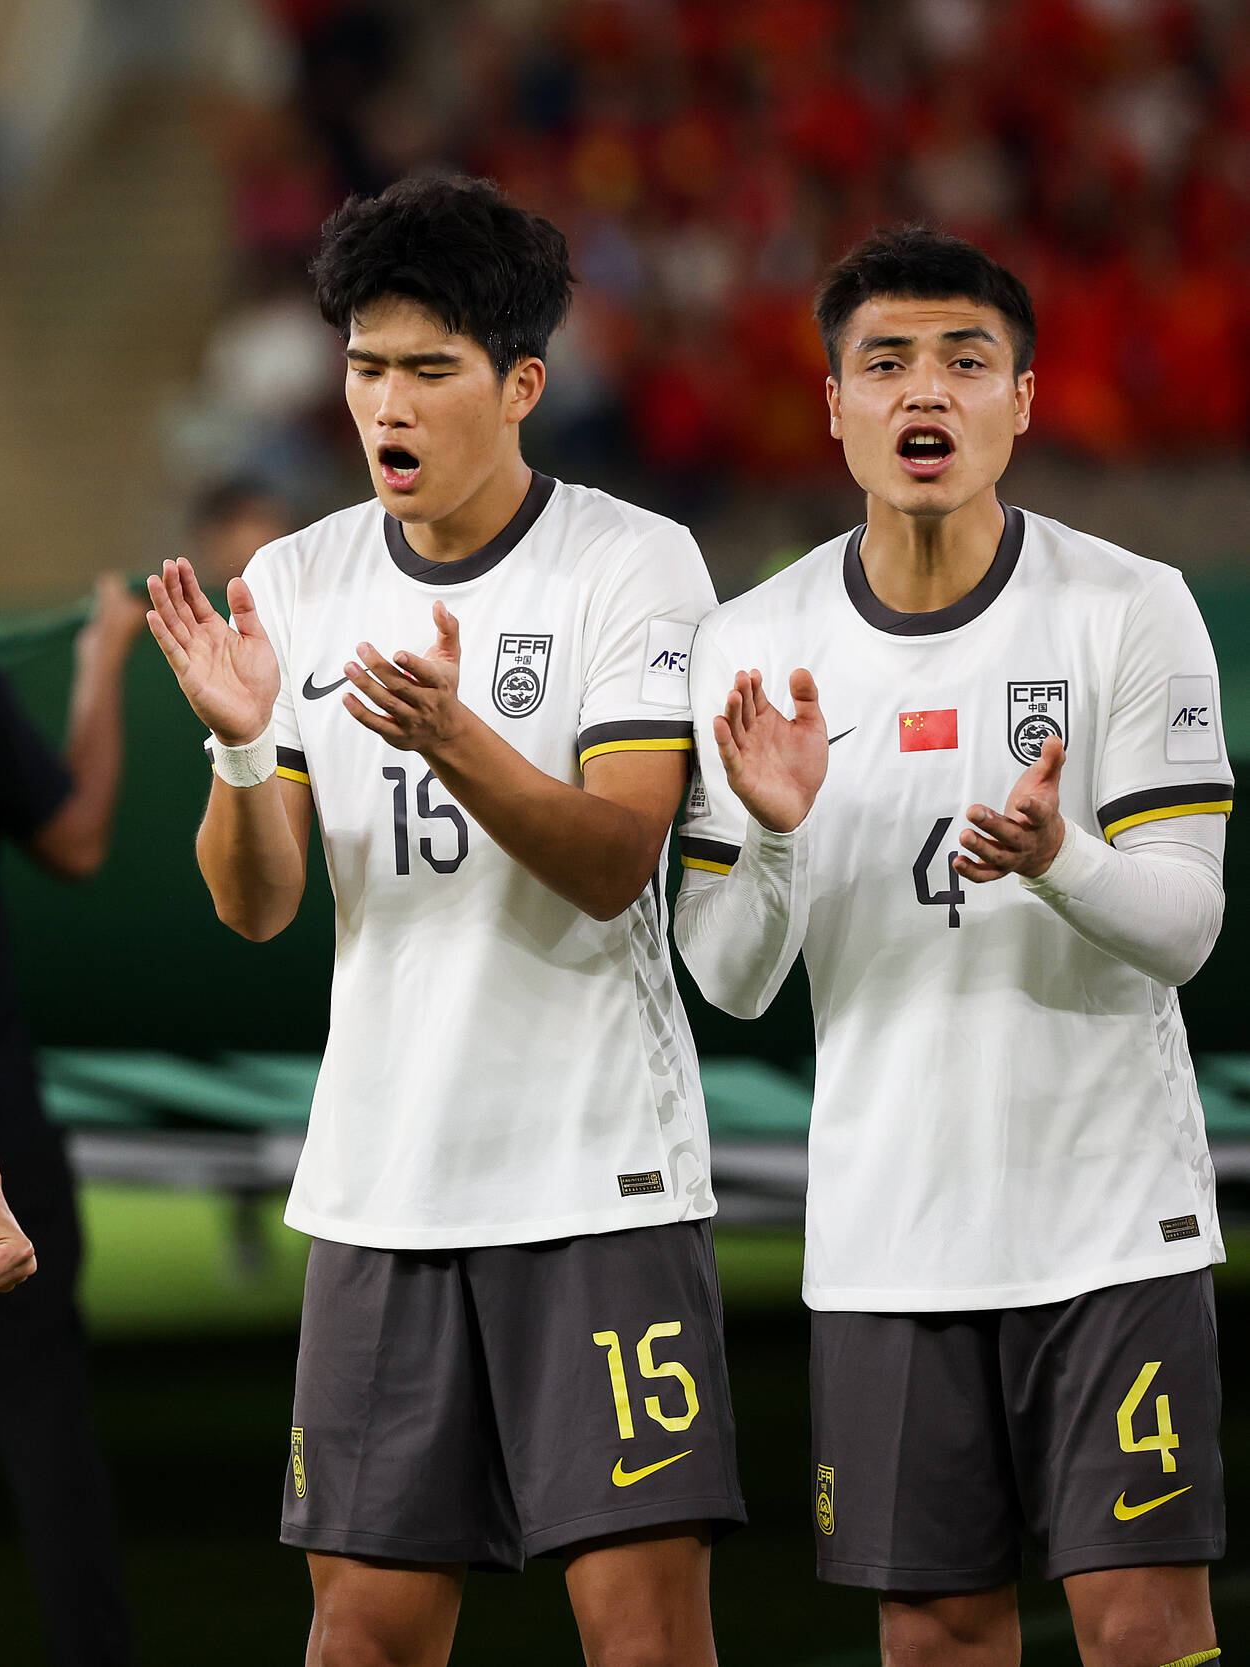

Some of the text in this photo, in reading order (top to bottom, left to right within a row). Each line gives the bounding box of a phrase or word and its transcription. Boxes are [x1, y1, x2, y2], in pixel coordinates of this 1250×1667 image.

[503, 639, 547, 655] CFA
[650, 650, 688, 672] AFC
[1013, 687, 1063, 702] CFA
[1171, 707, 1209, 727] AFC
[382, 766, 469, 876] 15
[912, 816, 966, 928] 4
[593, 1321, 700, 1440] 15
[1116, 1361, 1181, 1473] 4
